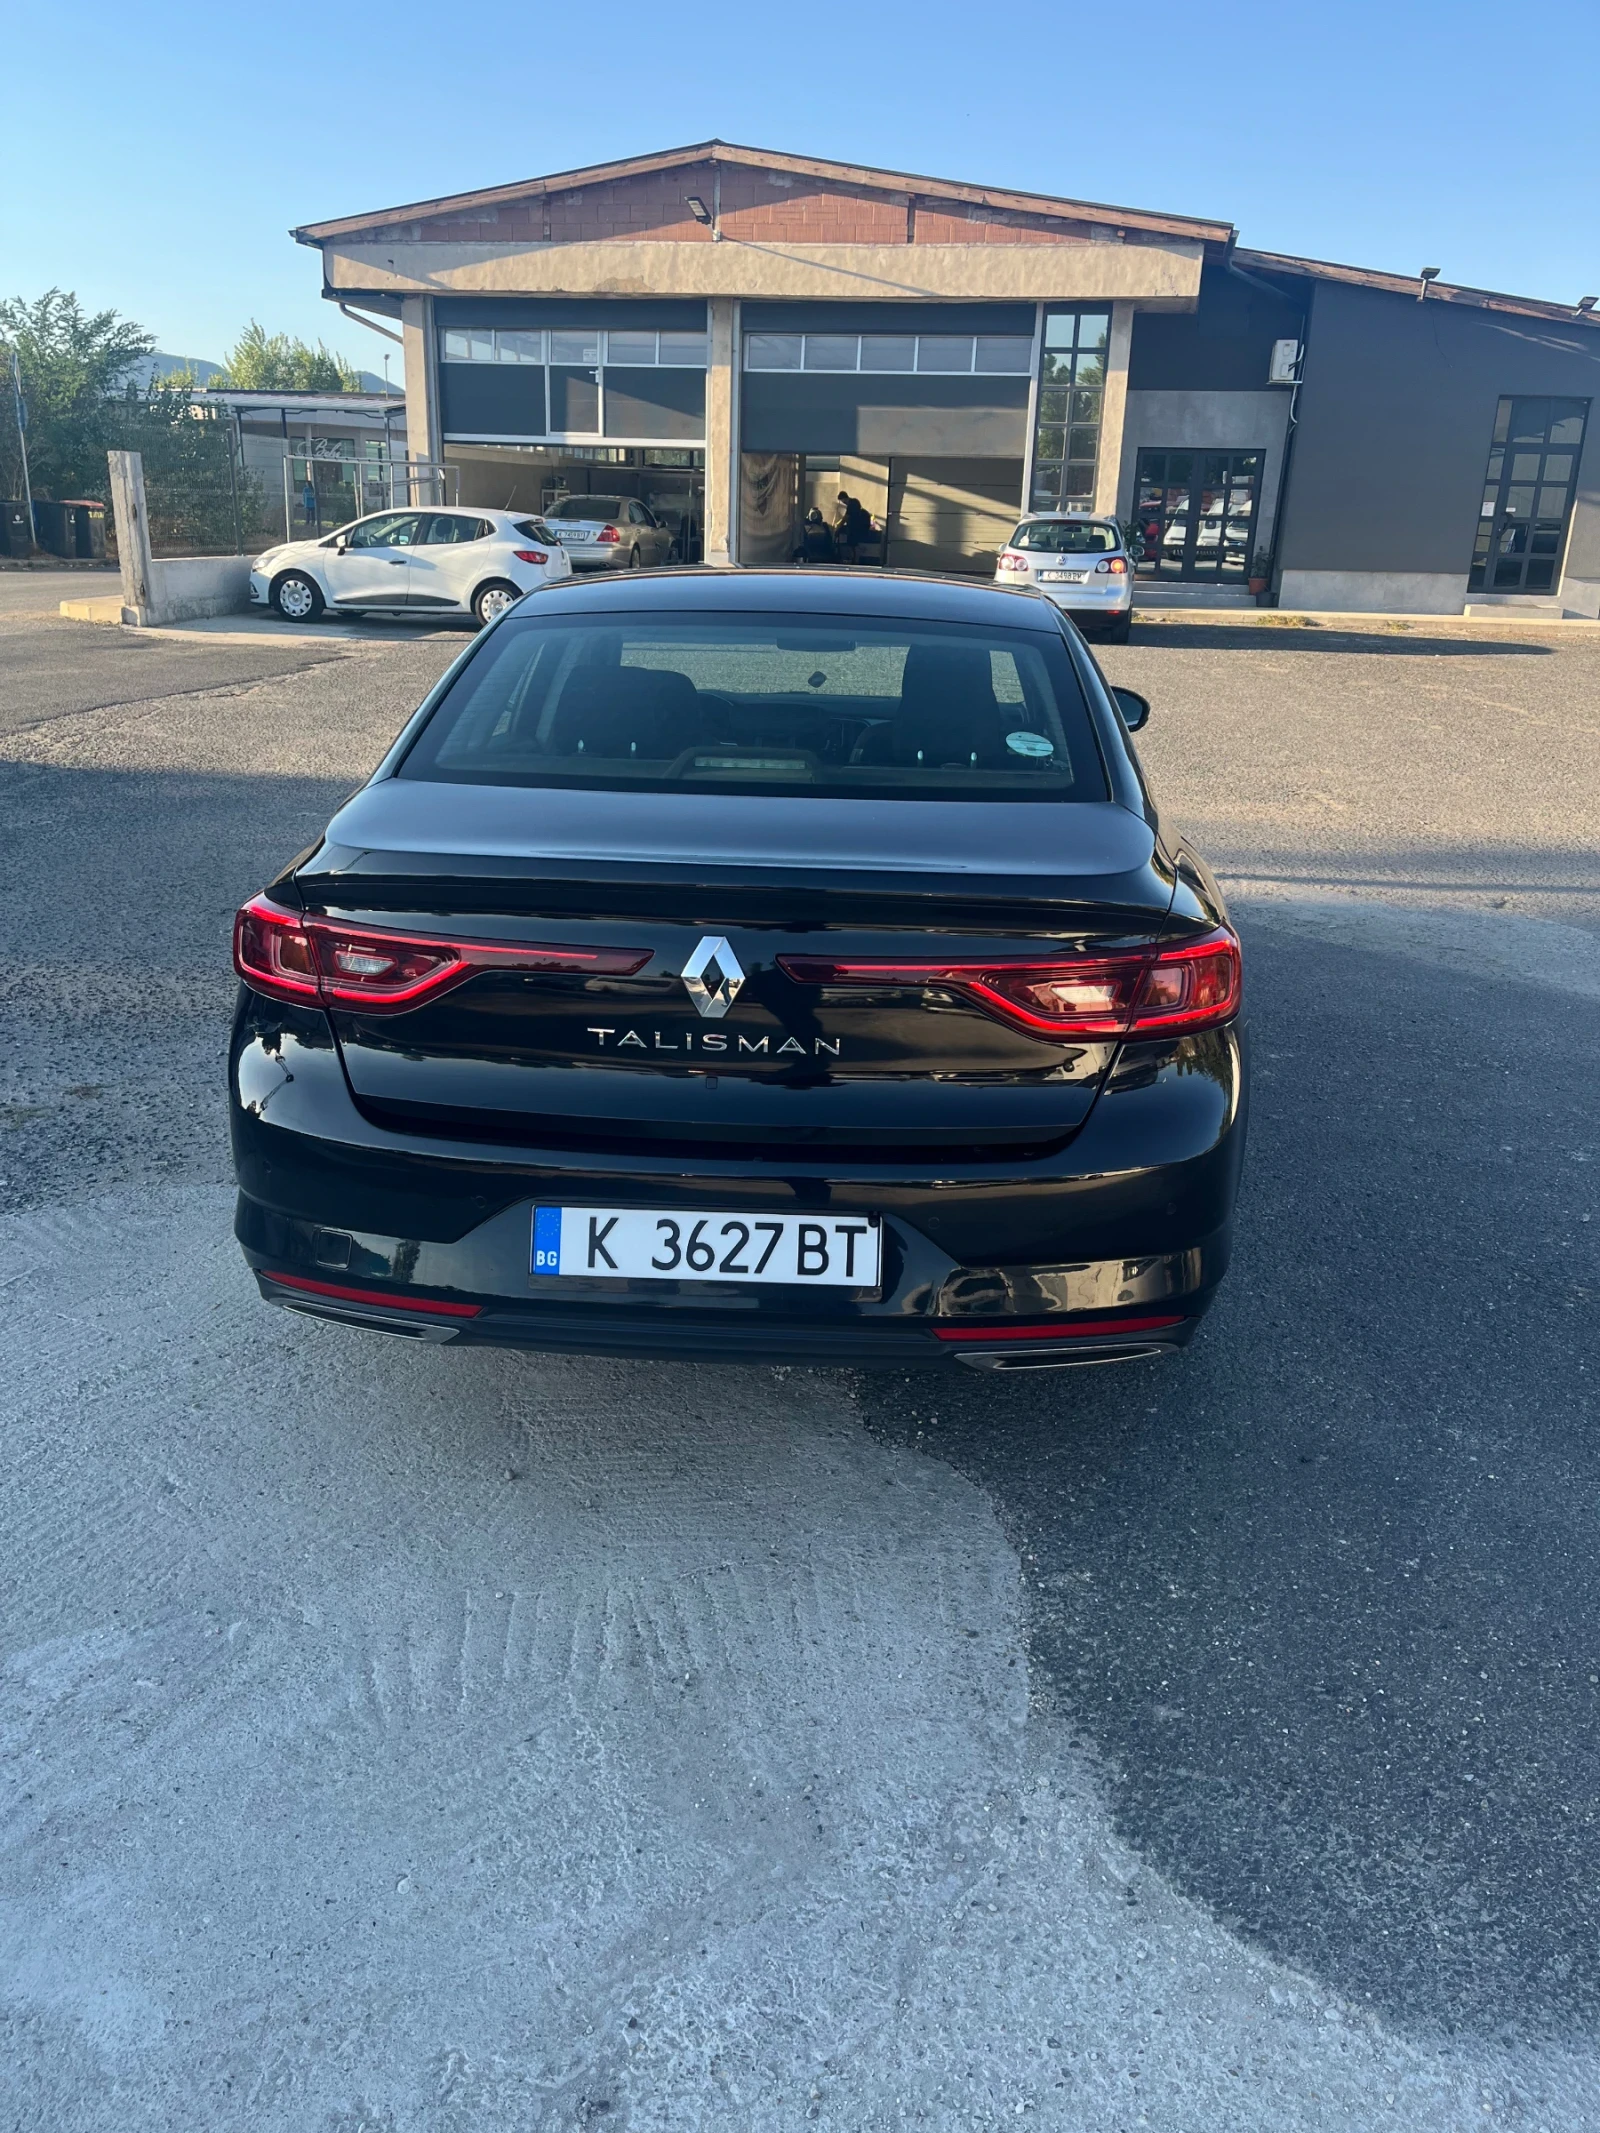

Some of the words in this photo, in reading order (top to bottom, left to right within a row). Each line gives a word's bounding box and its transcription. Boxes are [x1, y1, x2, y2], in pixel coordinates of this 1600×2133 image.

[587, 1027, 841, 1056] TALISMAN
[536, 1249, 558, 1267] BG
[587, 1216, 619, 1269] K
[651, 1218, 784, 1274] 3627
[797, 1223, 868, 1278] BT
